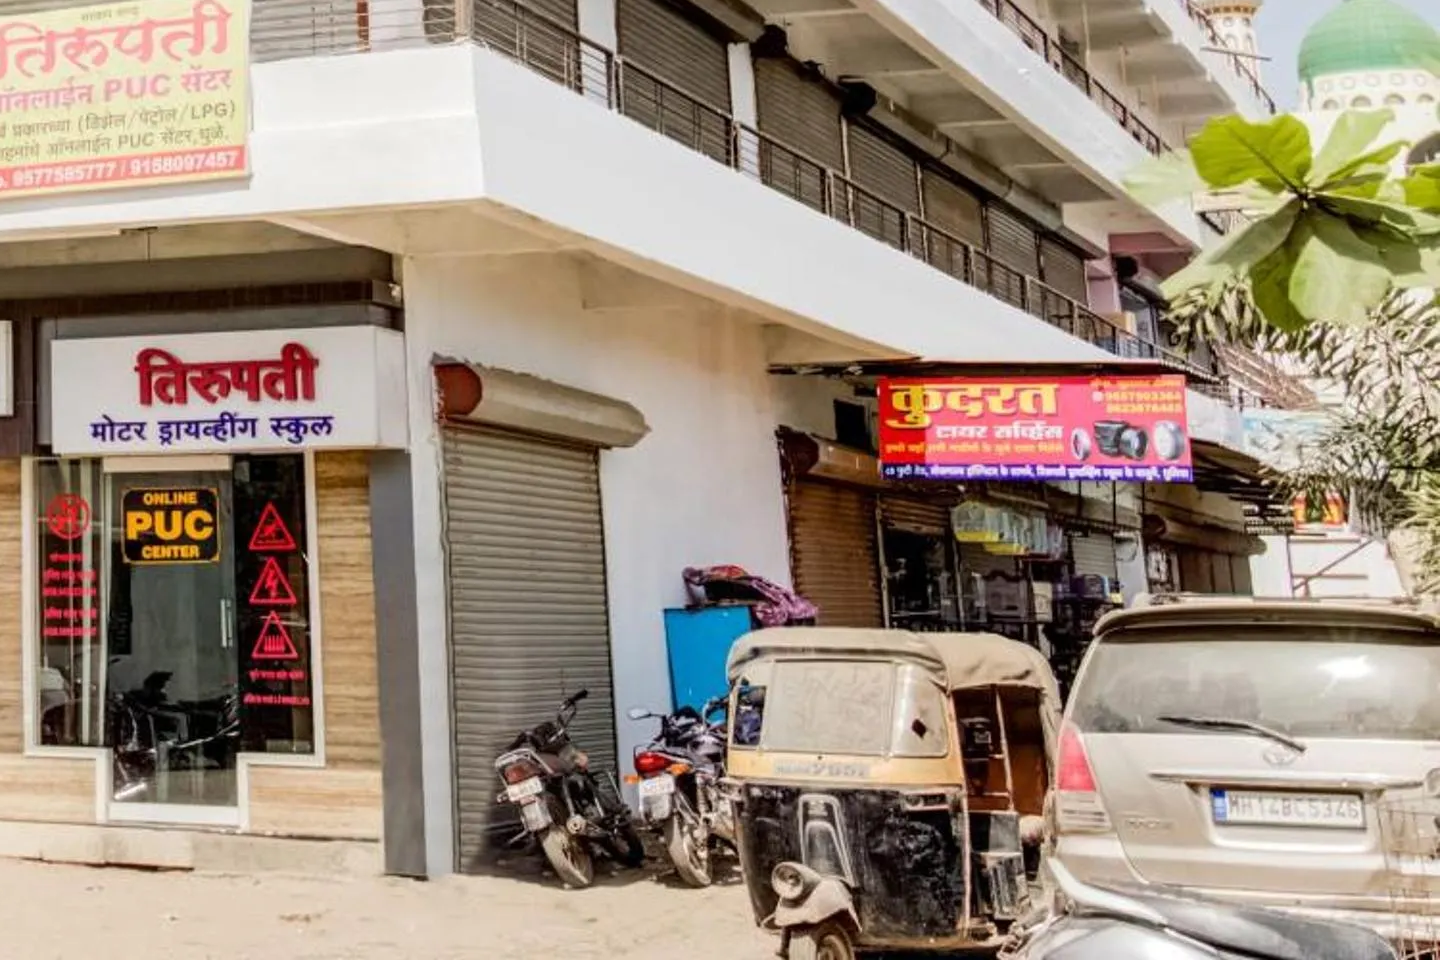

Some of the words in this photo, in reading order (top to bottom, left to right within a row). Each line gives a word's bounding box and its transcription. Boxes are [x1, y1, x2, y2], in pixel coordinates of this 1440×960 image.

[104, 74, 171, 102] PUC
[118, 131, 155, 149] PUC
[134, 342, 320, 407] तिरुपती
[886, 383, 1059, 429] कुदरत
[90, 414, 147, 442] मोटर
[270, 415, 334, 444] स्कुल
[935, 425, 988, 439] टायर
[143, 491, 198, 506] ONLINE
[126, 509, 213, 540] PUC
[142, 544, 200, 559] CENTER
